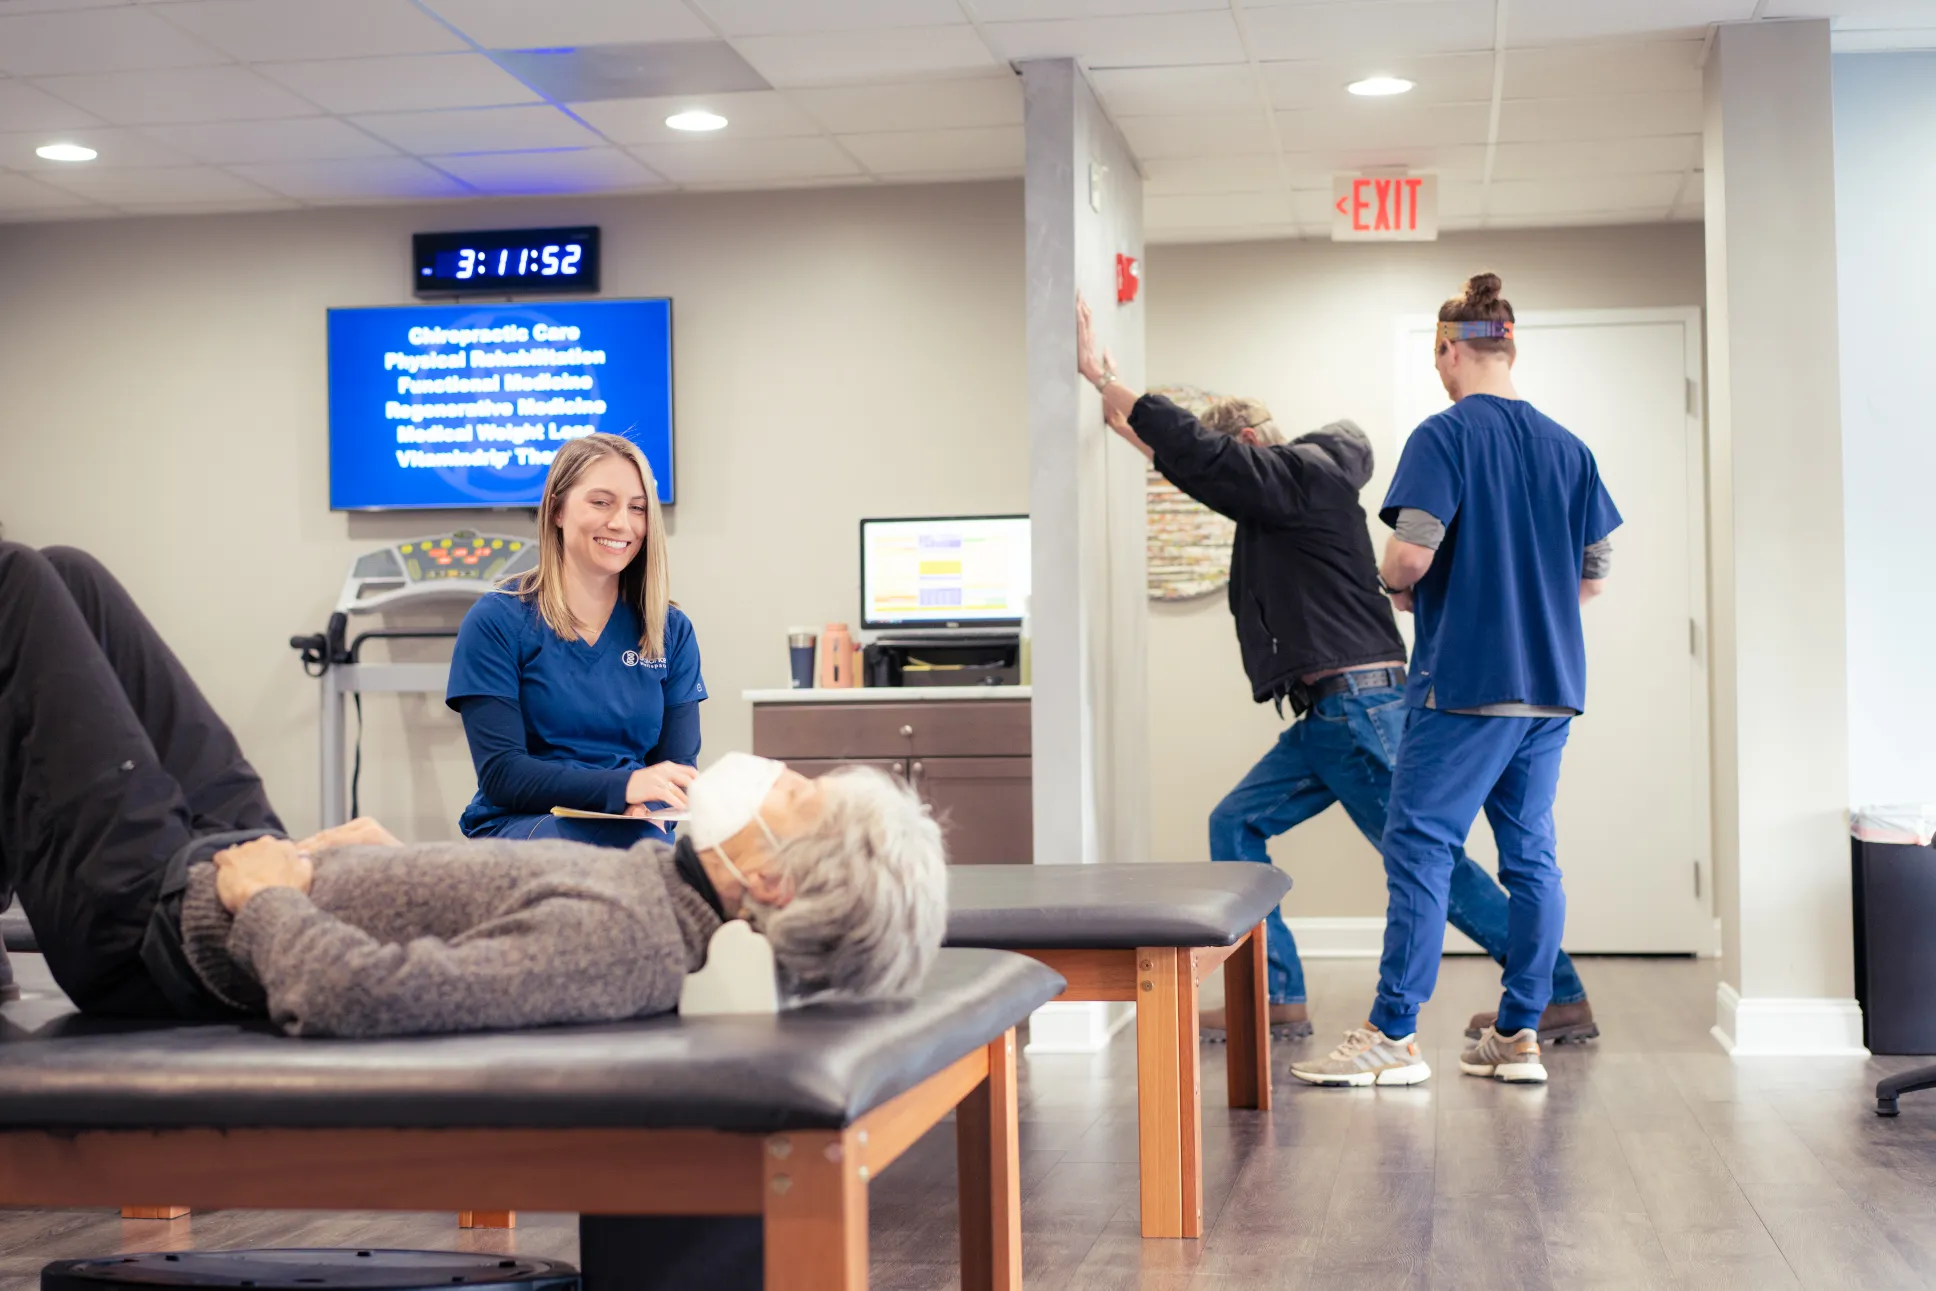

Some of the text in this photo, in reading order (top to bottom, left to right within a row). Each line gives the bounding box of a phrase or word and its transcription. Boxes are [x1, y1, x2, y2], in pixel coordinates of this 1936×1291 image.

[1352, 178, 1423, 231] EXIT
[456, 245, 582, 279] 3:11:52
[408, 323, 581, 347] Chiropractic Care
[384, 347, 606, 373] Physical Rehabilitation
[398, 372, 594, 395] Functional Medicine
[385, 396, 607, 423] Regenerative Medicine
[397, 423, 474, 444] Medical
[476, 422, 545, 445] Weight
